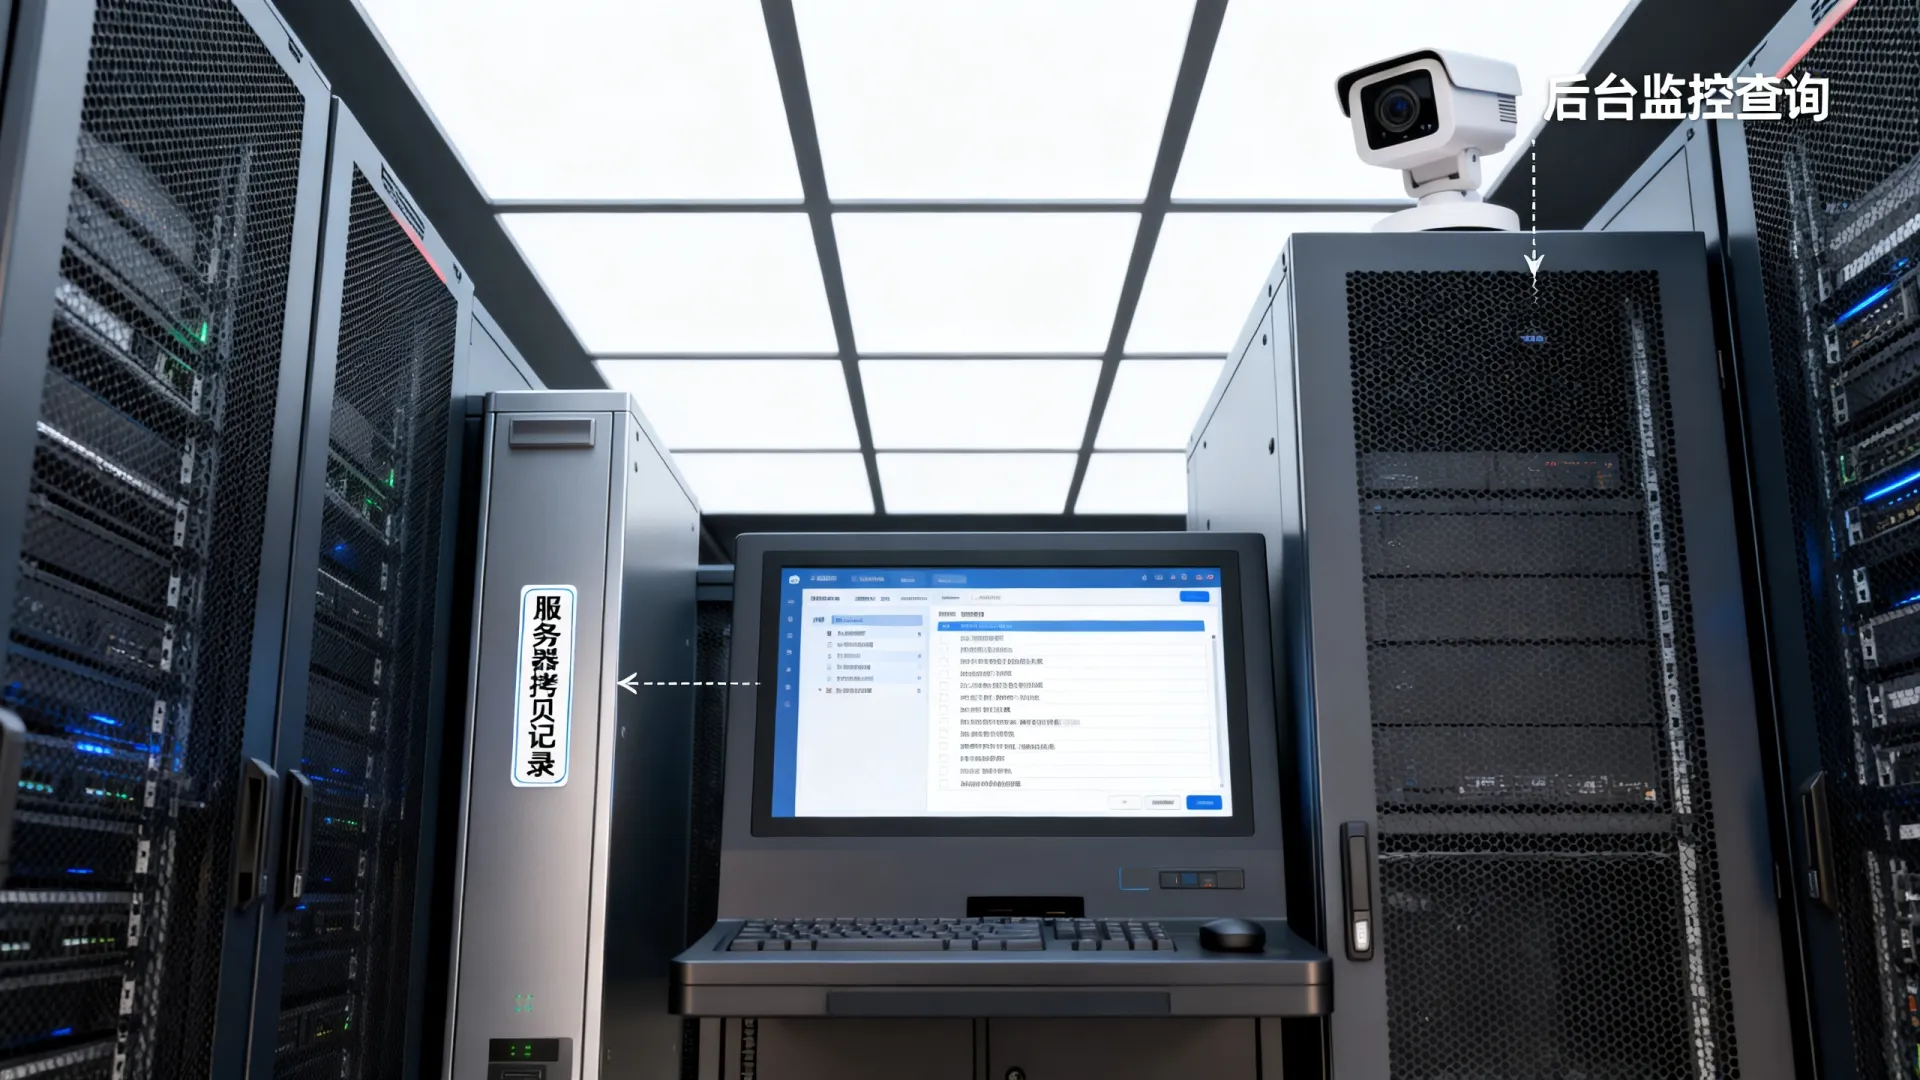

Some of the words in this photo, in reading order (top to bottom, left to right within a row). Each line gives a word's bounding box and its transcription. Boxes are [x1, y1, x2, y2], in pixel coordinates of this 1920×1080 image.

[526, 595, 562, 778] 服务器拷贝记录
